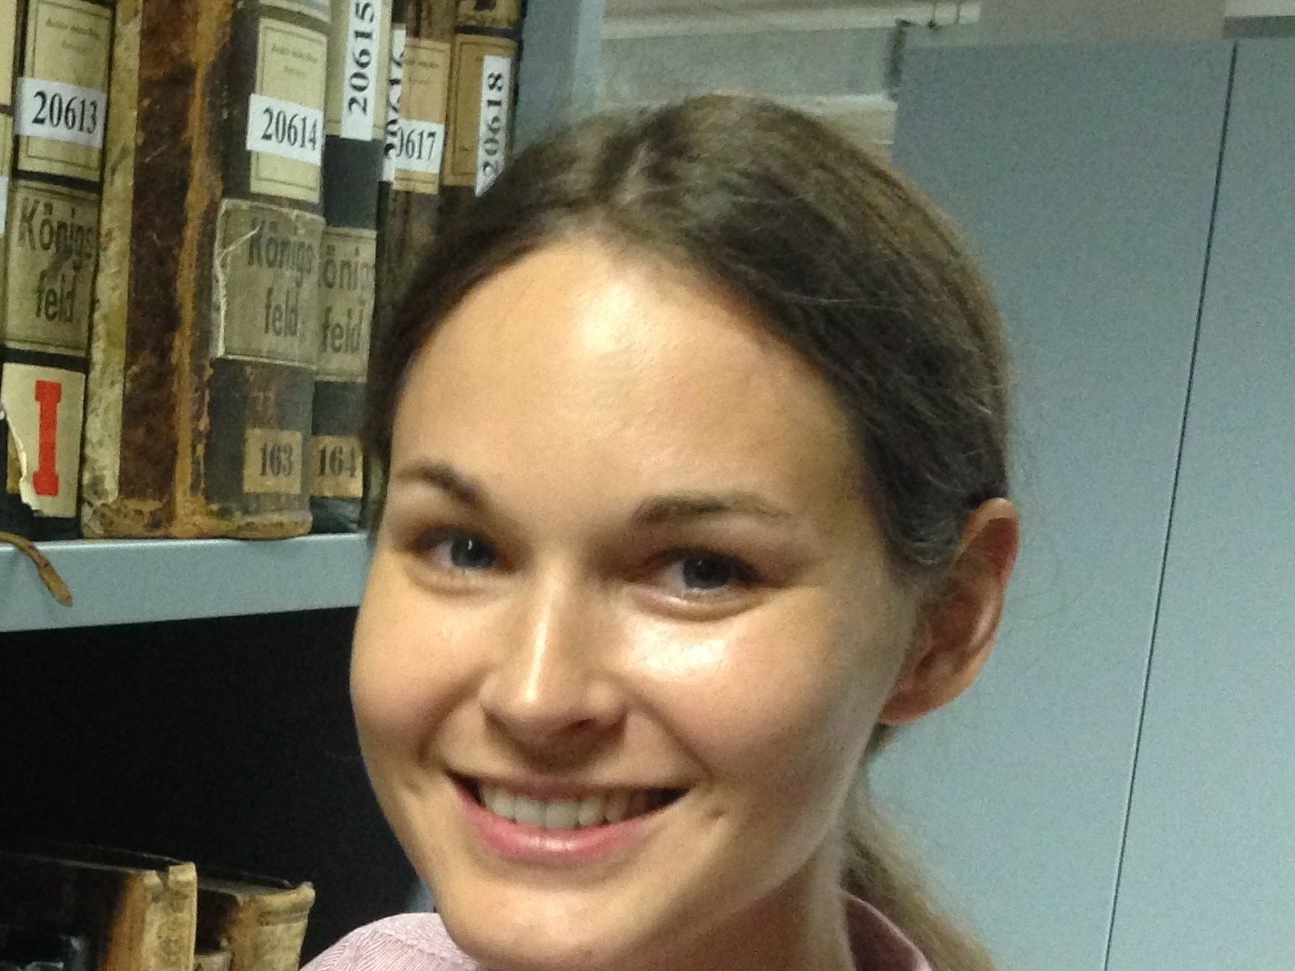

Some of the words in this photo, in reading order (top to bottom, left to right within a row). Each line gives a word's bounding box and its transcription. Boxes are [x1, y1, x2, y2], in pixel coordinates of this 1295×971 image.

[348, 1, 376, 116] 20615
[32, 90, 99, 135] 20613
[260, 106, 318, 152] 20614
[482, 71, 505, 174] 20618
[32, 380, 63, 498] I
[258, 440, 294, 478] 163
